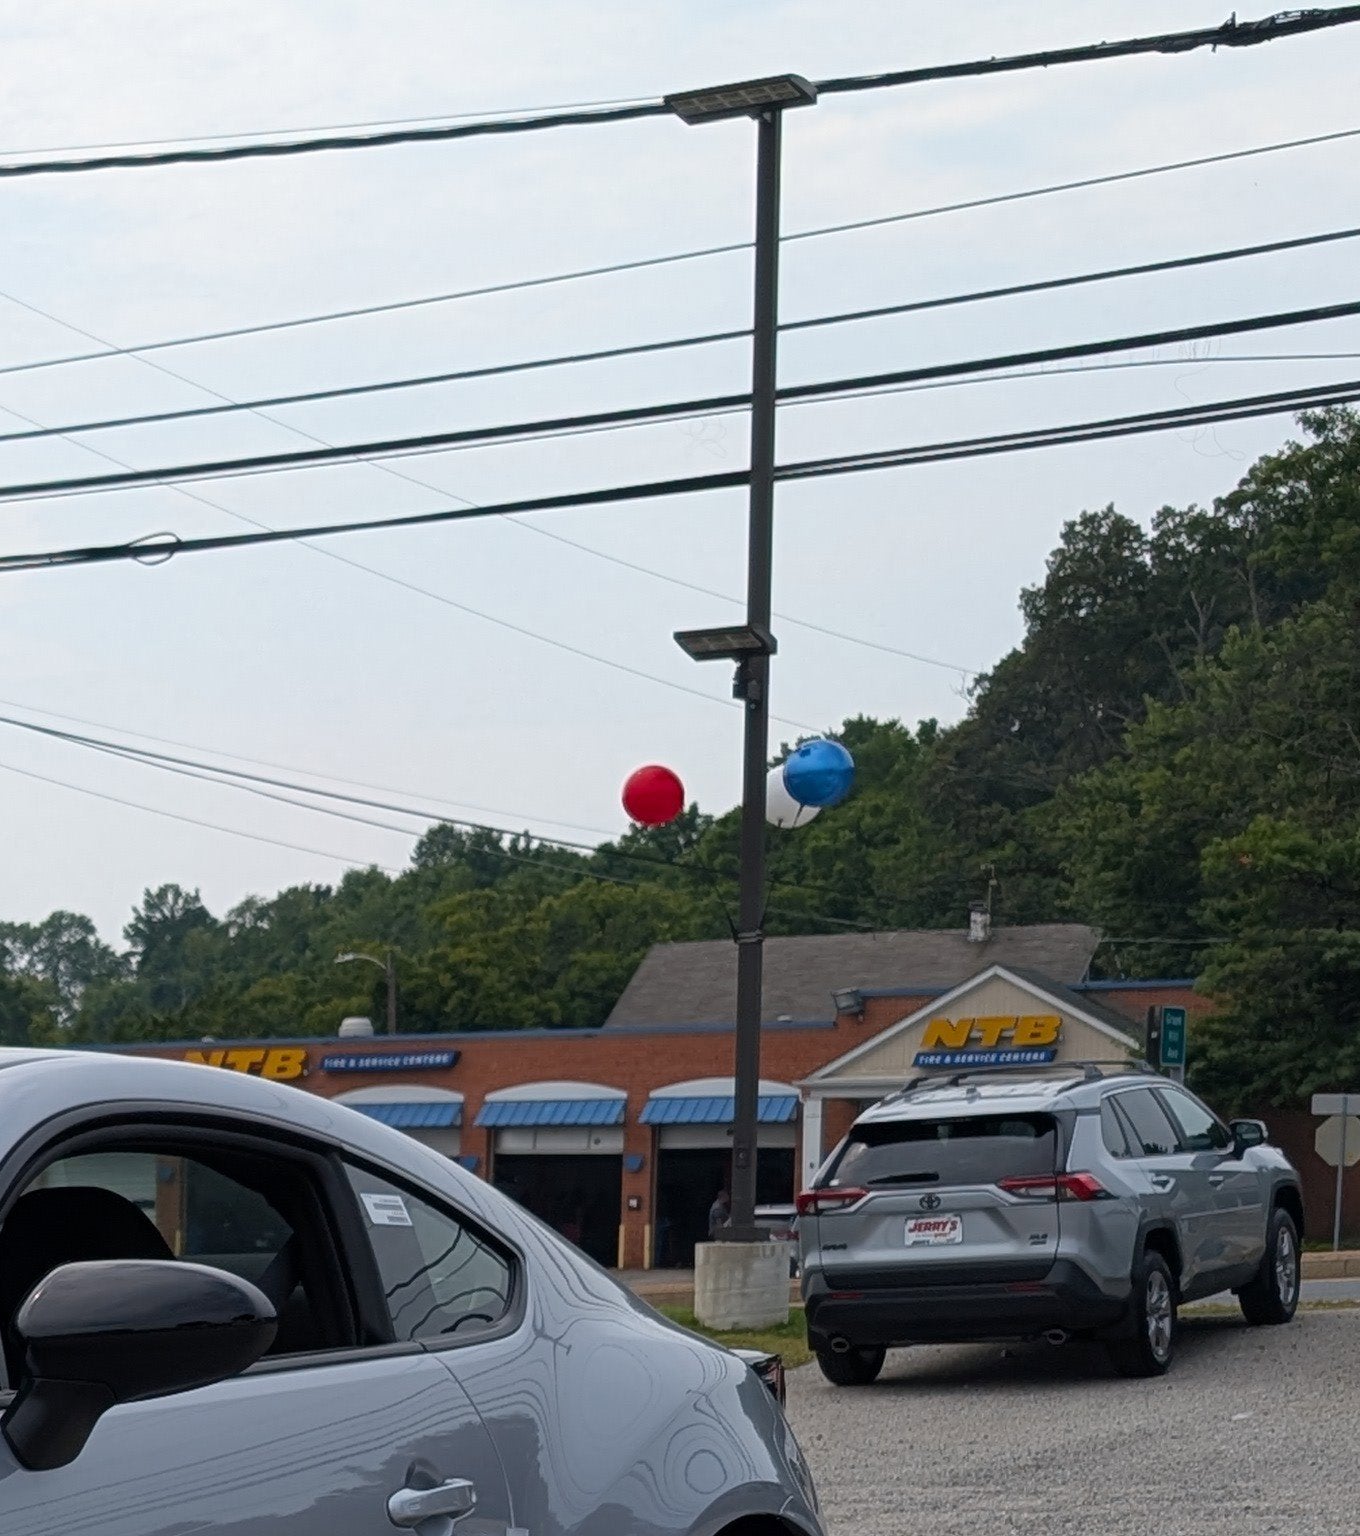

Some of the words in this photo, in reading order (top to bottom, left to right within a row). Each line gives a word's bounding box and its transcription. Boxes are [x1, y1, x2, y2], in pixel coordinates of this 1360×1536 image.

[920, 1014, 1063, 1049] NTB
[954, 1053, 997, 1063] SERVICE
[908, 1220, 958, 1233] JERRY'S
